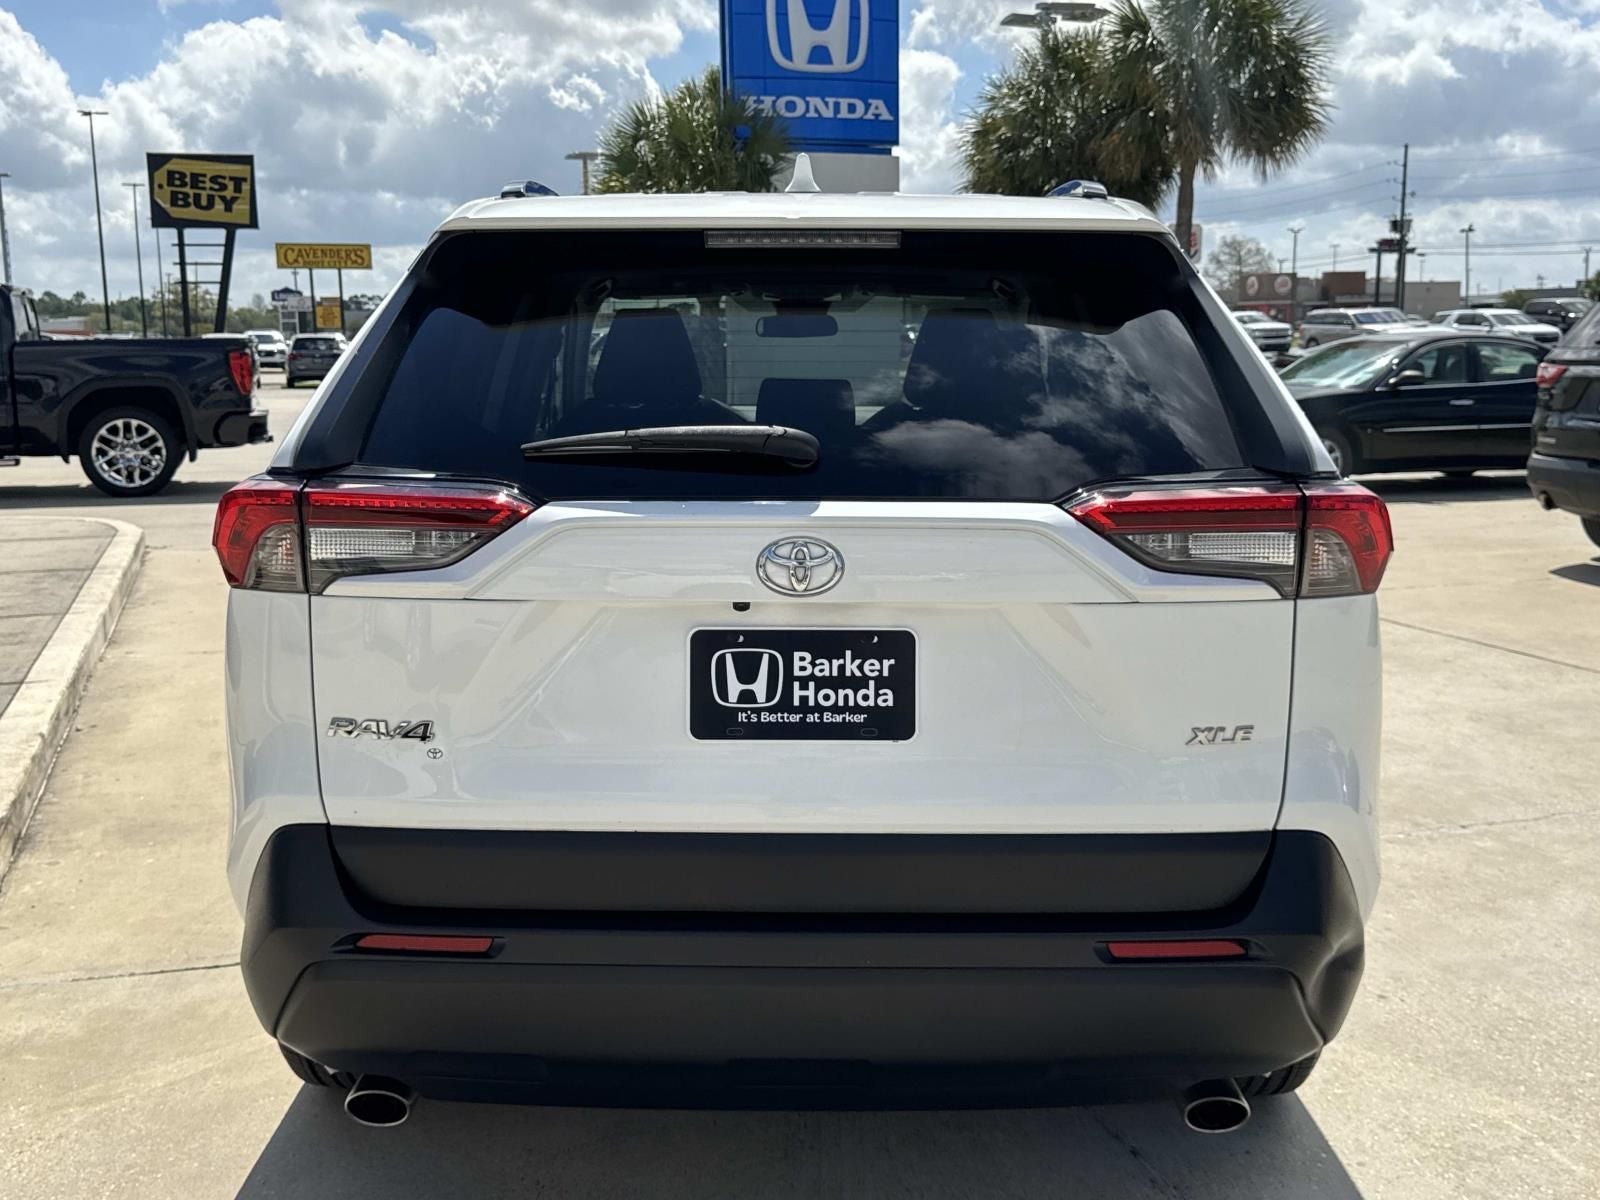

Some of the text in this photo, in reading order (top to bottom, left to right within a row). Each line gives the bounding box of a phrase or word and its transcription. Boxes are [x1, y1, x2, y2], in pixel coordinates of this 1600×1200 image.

[741, 95, 894, 121] HONDA
[166, 170, 248, 193] BEST
[170, 191, 241, 213] BUY
[283, 247, 365, 266] CAVENDER'S
[793, 650, 895, 677] Barker
[793, 680, 894, 707] Honda
[738, 710, 867, 723] It's Better at Barker
[327, 716, 435, 742] RAV4
[1185, 724, 1254, 745] XLE
